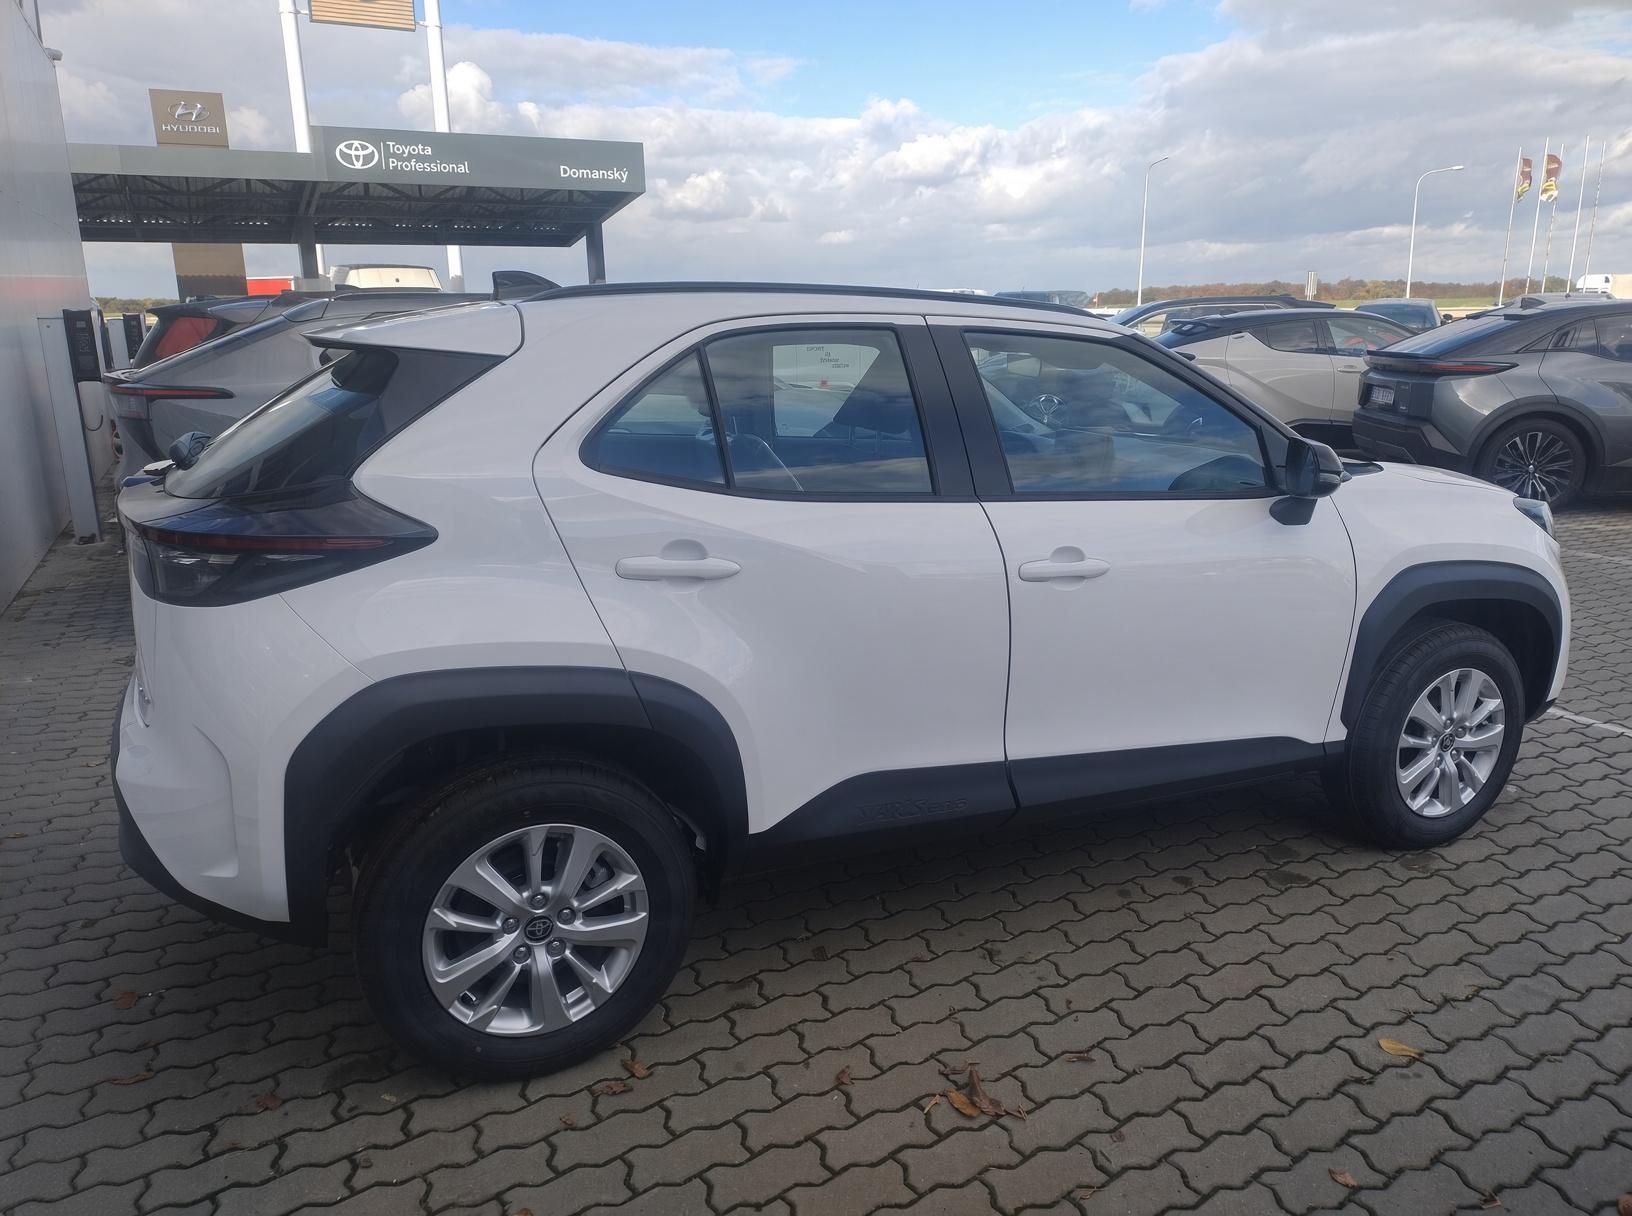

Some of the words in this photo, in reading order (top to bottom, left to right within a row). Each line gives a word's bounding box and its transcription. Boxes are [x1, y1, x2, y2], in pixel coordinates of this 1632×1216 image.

[162, 123, 220, 133] HYUNDAI
[386, 141, 432, 157] Toyota
[389, 158, 470, 174] Professional
[559, 165, 629, 184] Domanský
